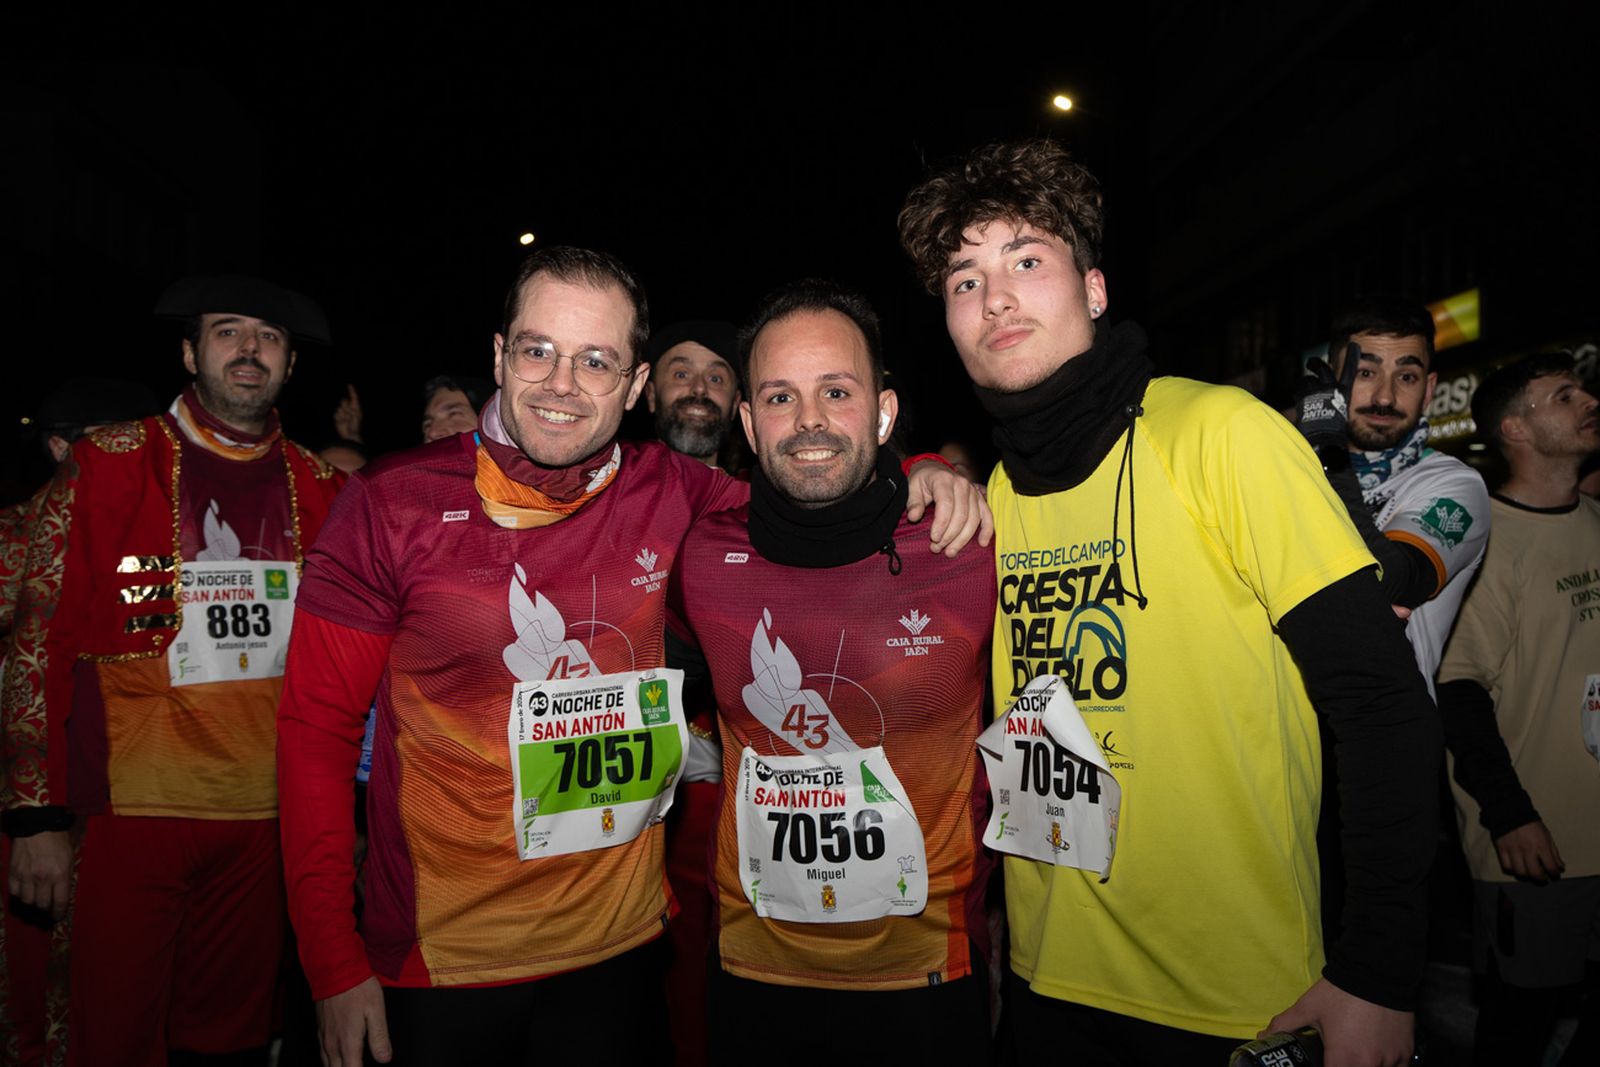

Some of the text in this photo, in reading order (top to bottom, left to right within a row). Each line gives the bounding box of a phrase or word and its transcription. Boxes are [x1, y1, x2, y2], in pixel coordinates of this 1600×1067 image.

[1303, 401, 1324, 411] SAN
[197, 574, 238, 587] NOCHE
[240, 574, 254, 585] DE
[999, 563, 1126, 615] CRESTA
[182, 590, 210, 603] SAN
[212, 585, 255, 602] ANTÓN
[207, 603, 271, 639] 883
[912, 635, 944, 645] RURAL
[1011, 616, 1065, 659] DEL
[530, 696, 548, 710] 43
[552, 691, 625, 715] NOCHE DE
[1011, 695, 1052, 712] NOCH
[532, 709, 625, 741] SAN ANTÓN
[781, 704, 830, 749] 43
[1007, 717, 1028, 736] AN
[553, 731, 653, 794] 7057
[823, 772, 844, 787] DE
[1014, 740, 1102, 804] 7054
[591, 790, 621, 805] David
[1046, 802, 1066, 818] Juan
[767, 809, 886, 865] 7056
[807, 867, 846, 883] Miguel
